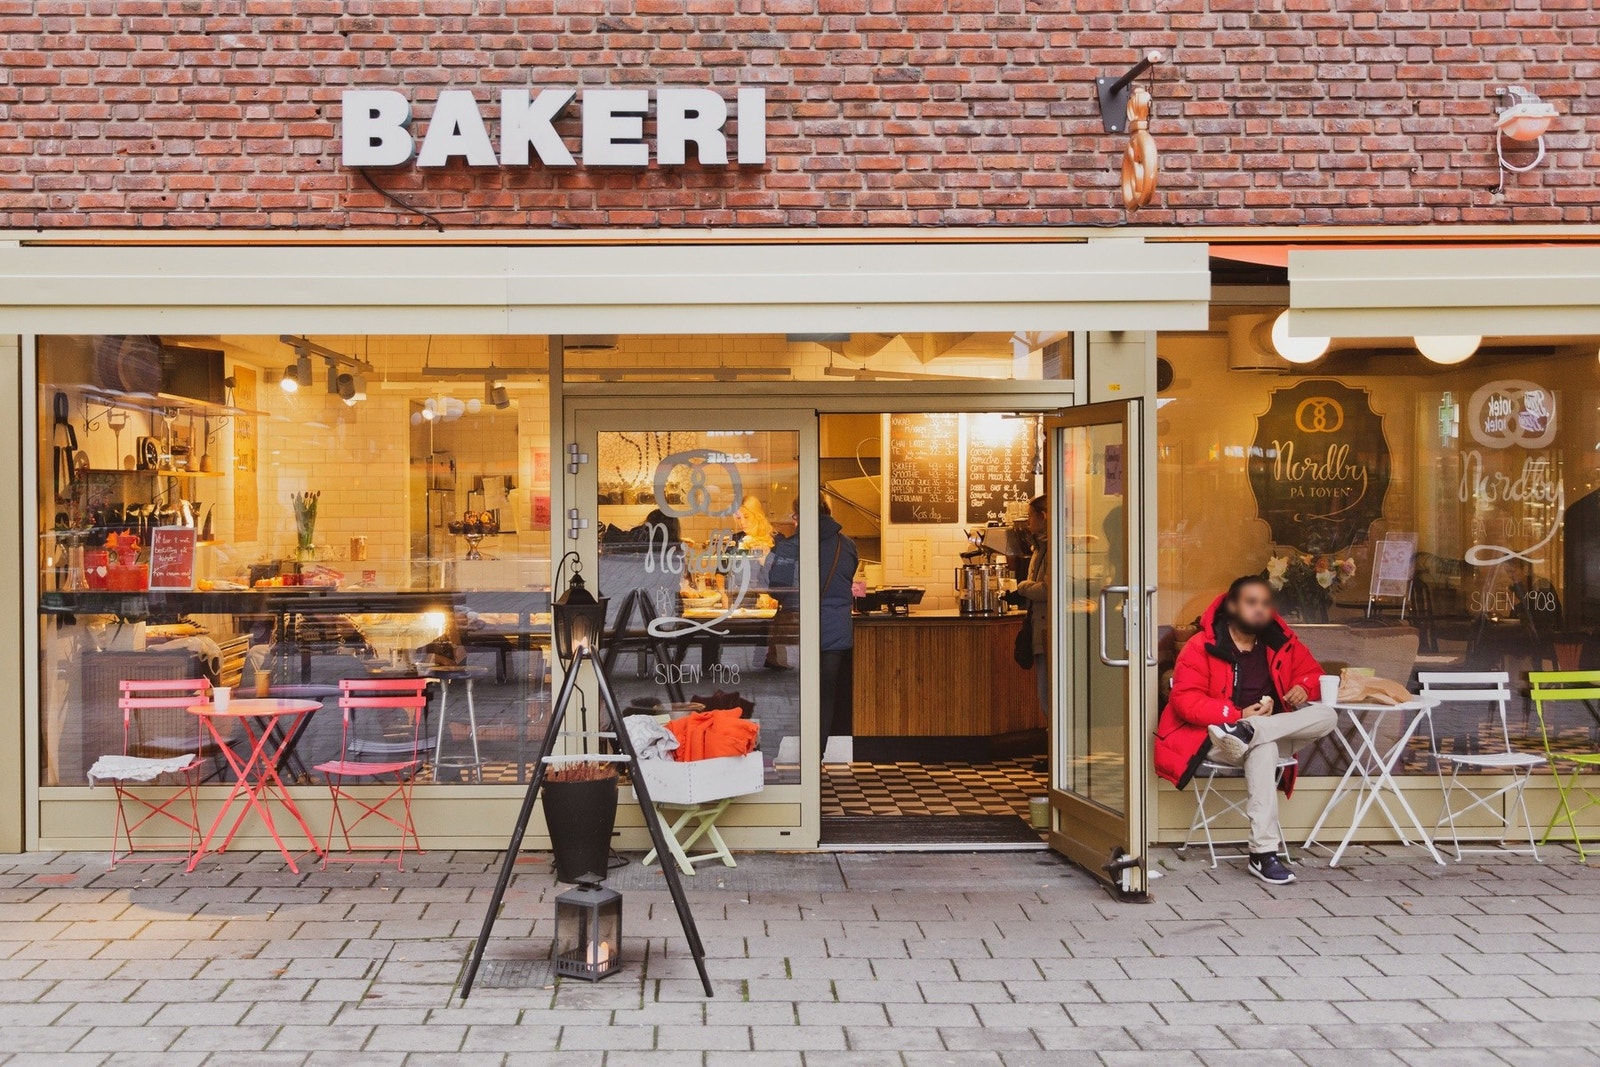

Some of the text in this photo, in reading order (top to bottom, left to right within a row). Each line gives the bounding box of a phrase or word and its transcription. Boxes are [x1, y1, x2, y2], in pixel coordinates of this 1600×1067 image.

[342, 87, 767, 167] BAKERI
[1272, 440, 1368, 506] Nordby
[1309, 487, 1349, 498] TØYEN
[1458, 450, 1565, 533] Nordby
[644, 522, 751, 607] Nordby
[1470, 590, 1556, 612] SIDEN 1908
[655, 663, 741, 685] SIDEN 1908
